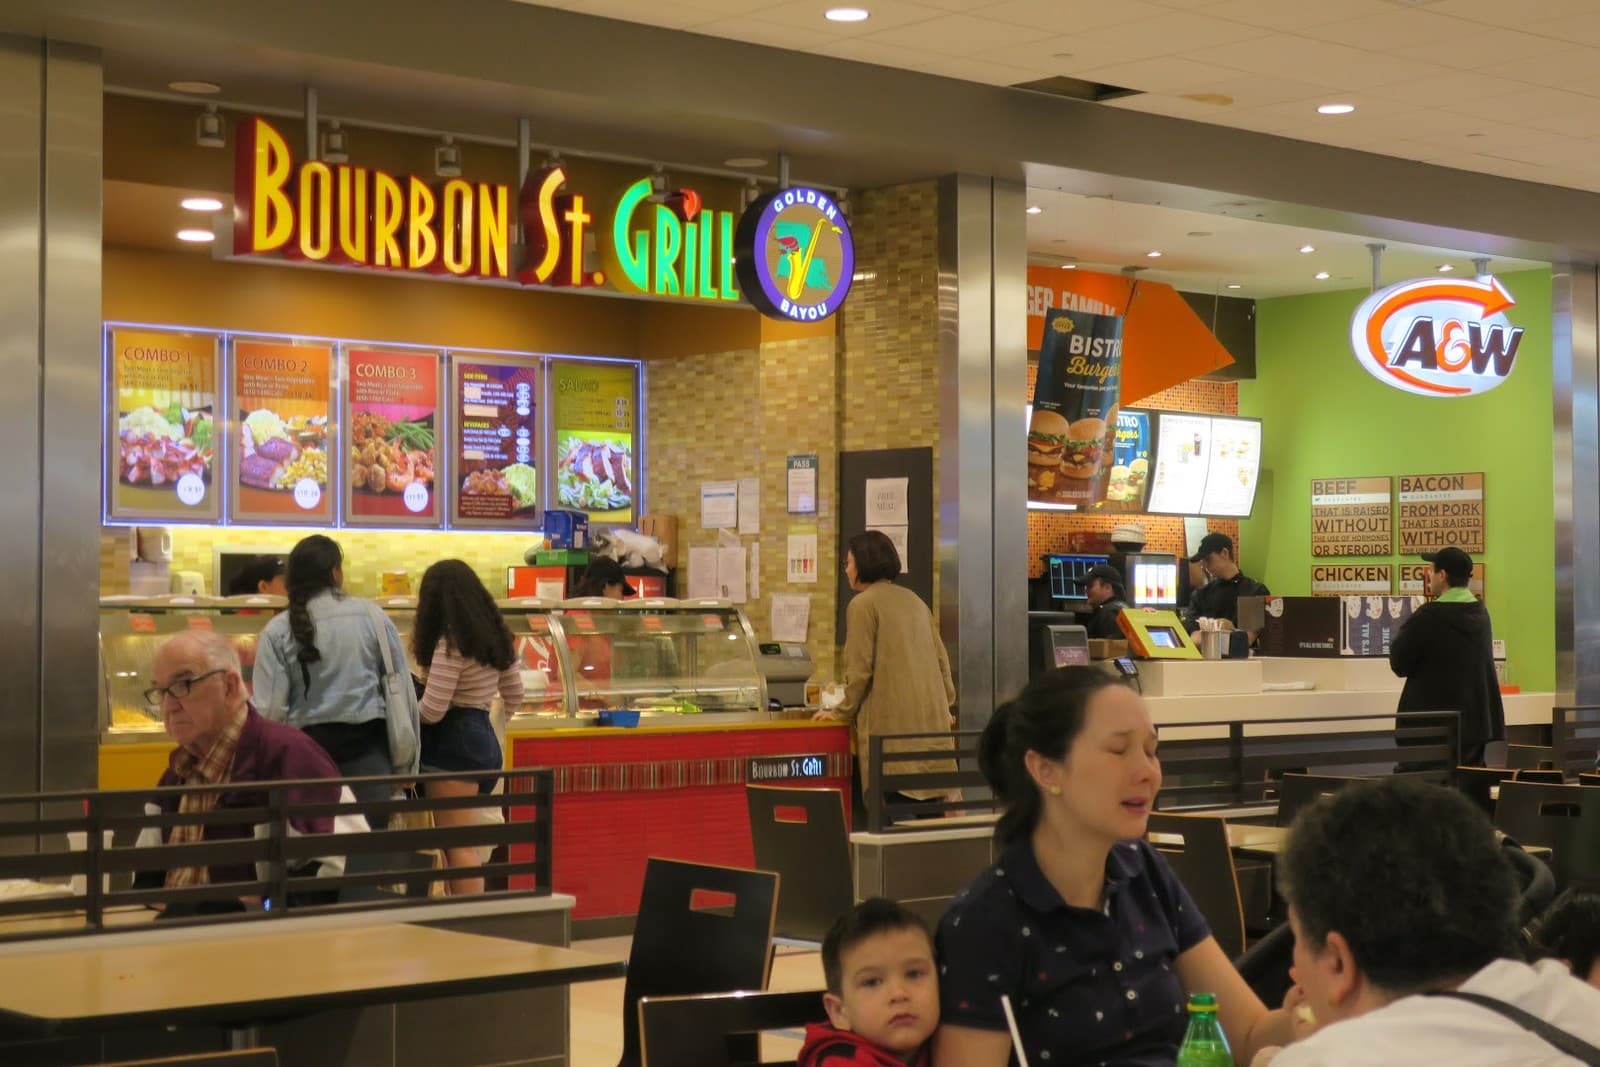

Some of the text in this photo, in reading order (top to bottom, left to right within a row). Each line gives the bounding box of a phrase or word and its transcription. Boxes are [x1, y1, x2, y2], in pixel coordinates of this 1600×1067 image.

[251, 116, 508, 278] BOURBON
[612, 178, 740, 301] GRILL
[774, 190, 837, 220] GOLDEN
[780, 299, 827, 320] BAYOU
[1391, 315, 1525, 377] A&W
[124, 347, 180, 362] COMBO
[243, 357, 308, 373] COMBO 2
[356, 363, 416, 380] COMBO 3
[793, 460, 810, 468] PASS
[1313, 480, 1357, 496] BEEF
[1400, 476, 1464, 492] BACON
[1314, 506, 1389, 516] THAT IS RAISED
[1401, 503, 1480, 517] FROM PORK
[1314, 518, 1389, 533] WITHOUT
[1402, 517, 1480, 528] THAT IS RAISED
[1401, 530, 1481, 545] WITHOUT
[1313, 544, 1389, 555] OR STEROIDS
[1314, 567, 1388, 582] CHICKEN
[752, 761, 788, 779] BOURBON
